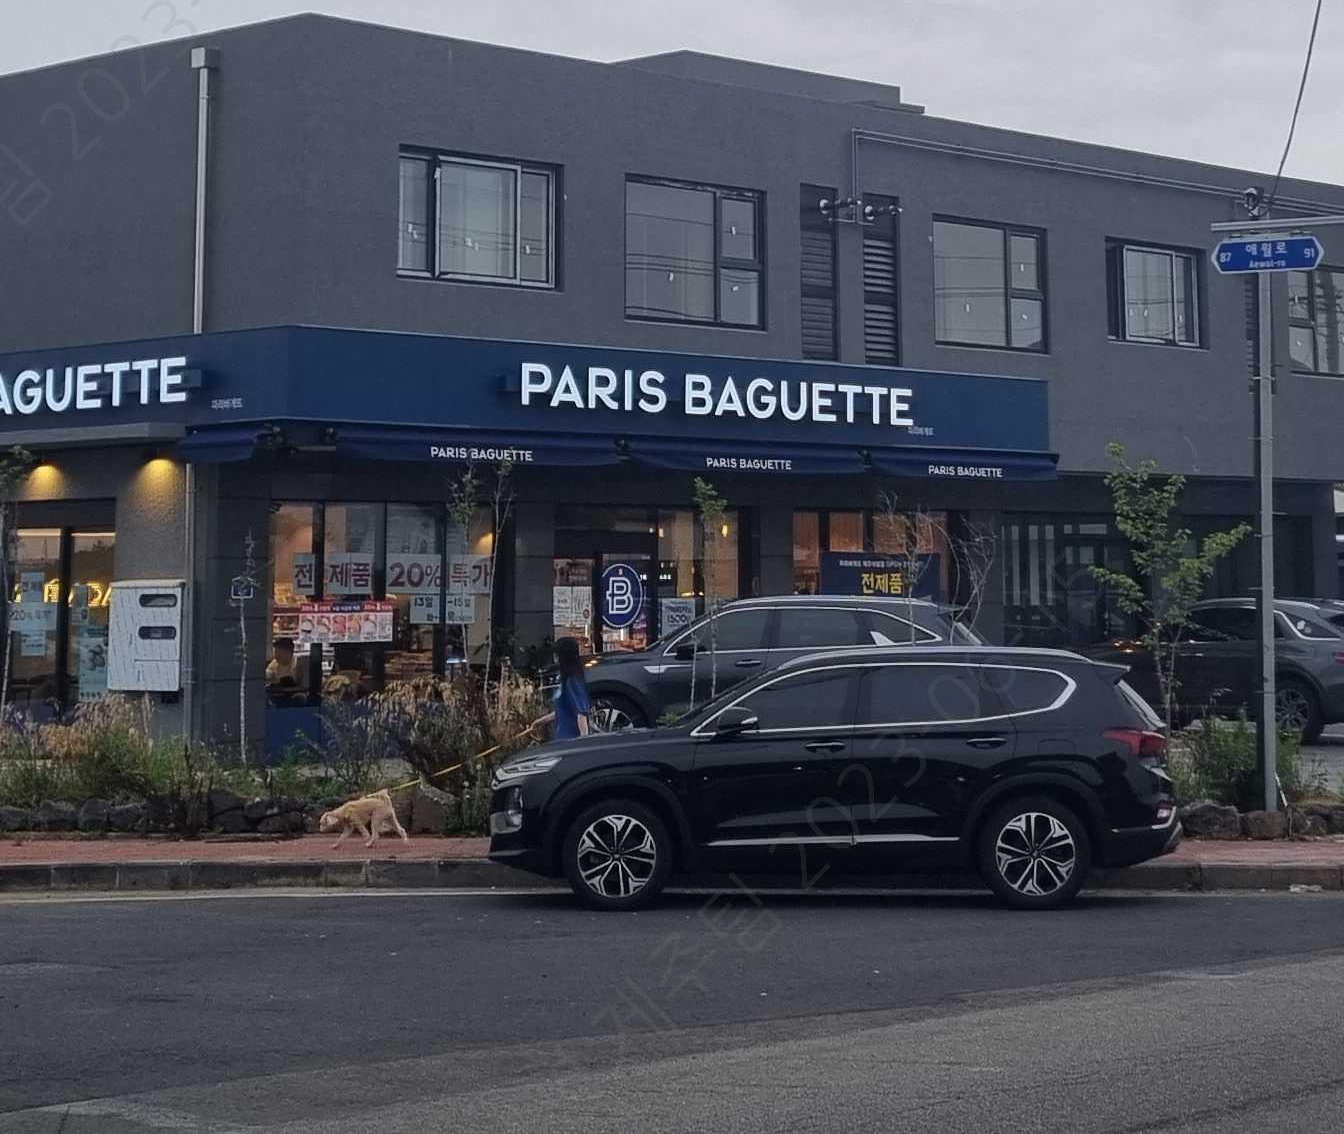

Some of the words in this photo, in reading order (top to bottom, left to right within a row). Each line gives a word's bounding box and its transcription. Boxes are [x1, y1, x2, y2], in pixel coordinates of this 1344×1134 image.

[1219, 252, 1232, 263] 87
[1245, 241, 1287, 258] 애월로
[521, 362, 668, 413] PARIS
[685, 374, 914, 426] BAGUETTE
[430, 446, 467, 459] PARIS
[471, 448, 534, 462] BAGUETTE
[706, 457, 737, 469] PARIS
[739, 458, 792, 471] BAGUETTE
[928, 465, 955, 476] PARIS
[957, 466, 1004, 478] BAGUETTE
[389, 562, 441, 589] 20%
[451, 562, 490, 587] 특가
[861, 573, 903, 594] 전제품
